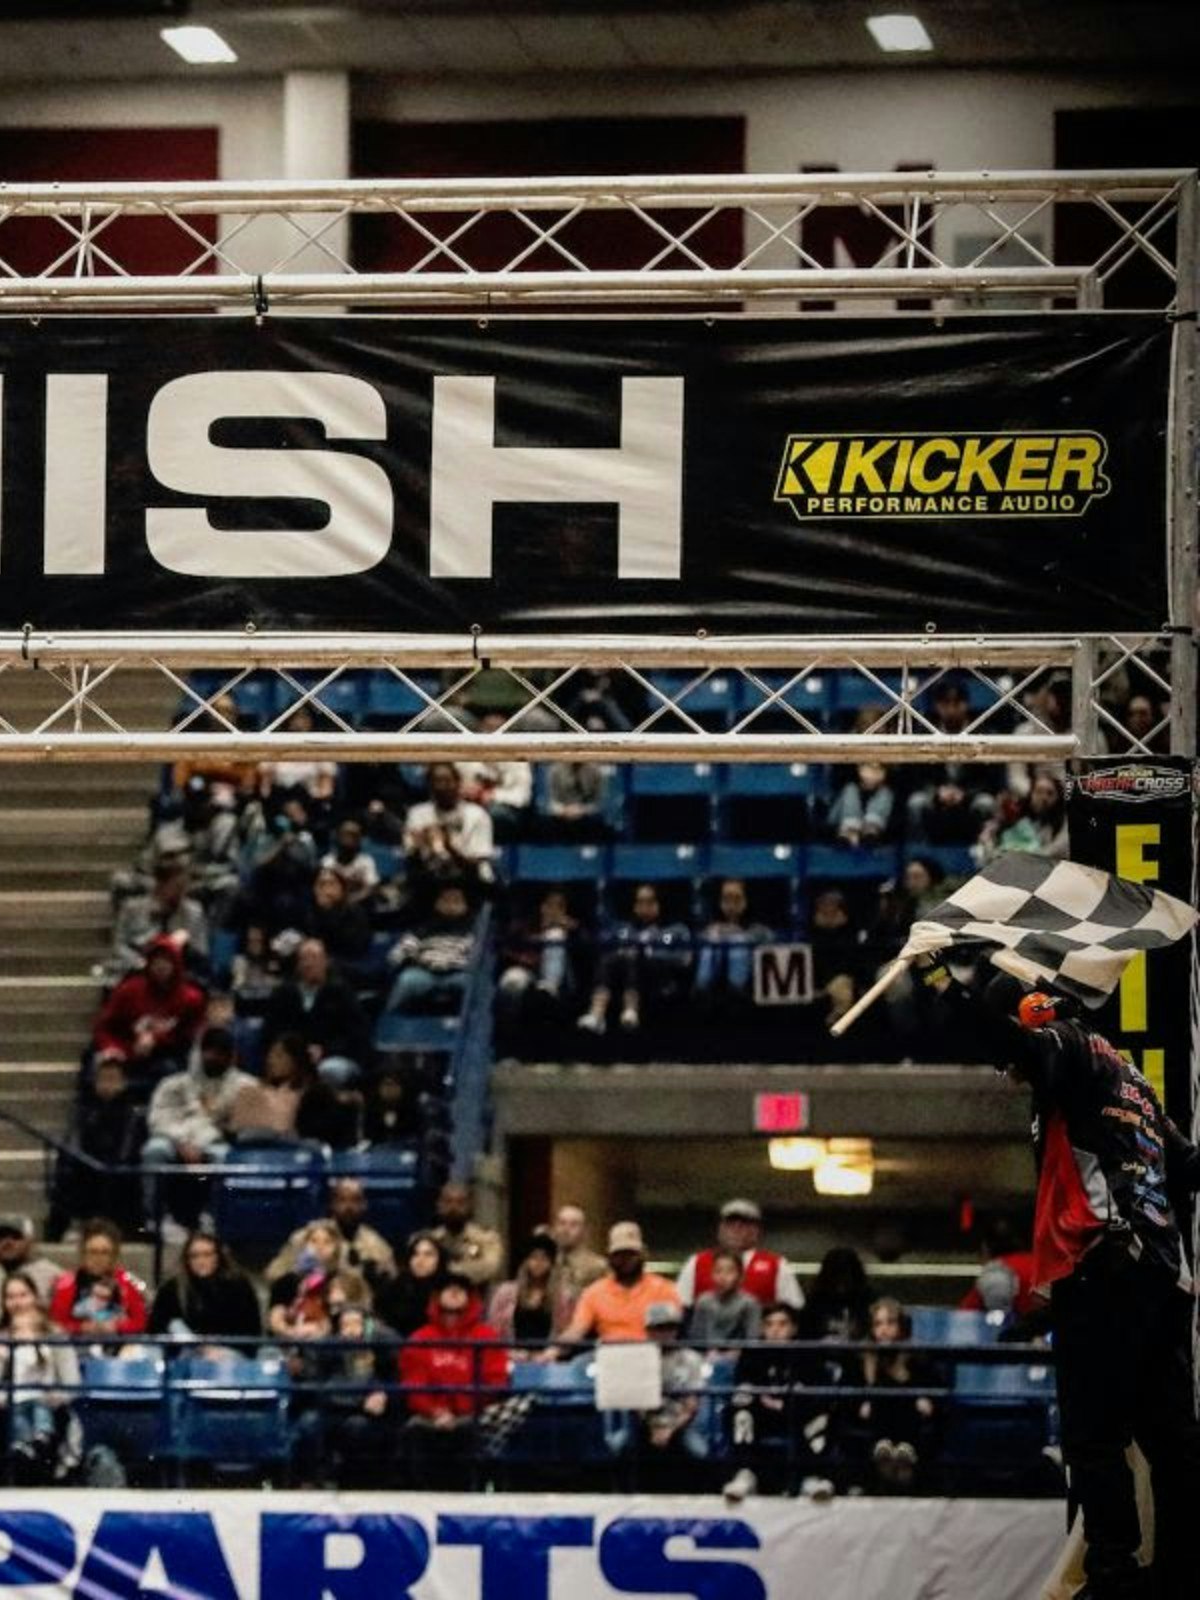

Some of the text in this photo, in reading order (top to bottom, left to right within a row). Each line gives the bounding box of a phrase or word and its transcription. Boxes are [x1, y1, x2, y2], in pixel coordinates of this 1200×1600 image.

[839, 438, 1101, 493] KICKER
[807, 495, 1075, 512] PERFORMANCE AUDIO
[761, 951, 806, 997] M
